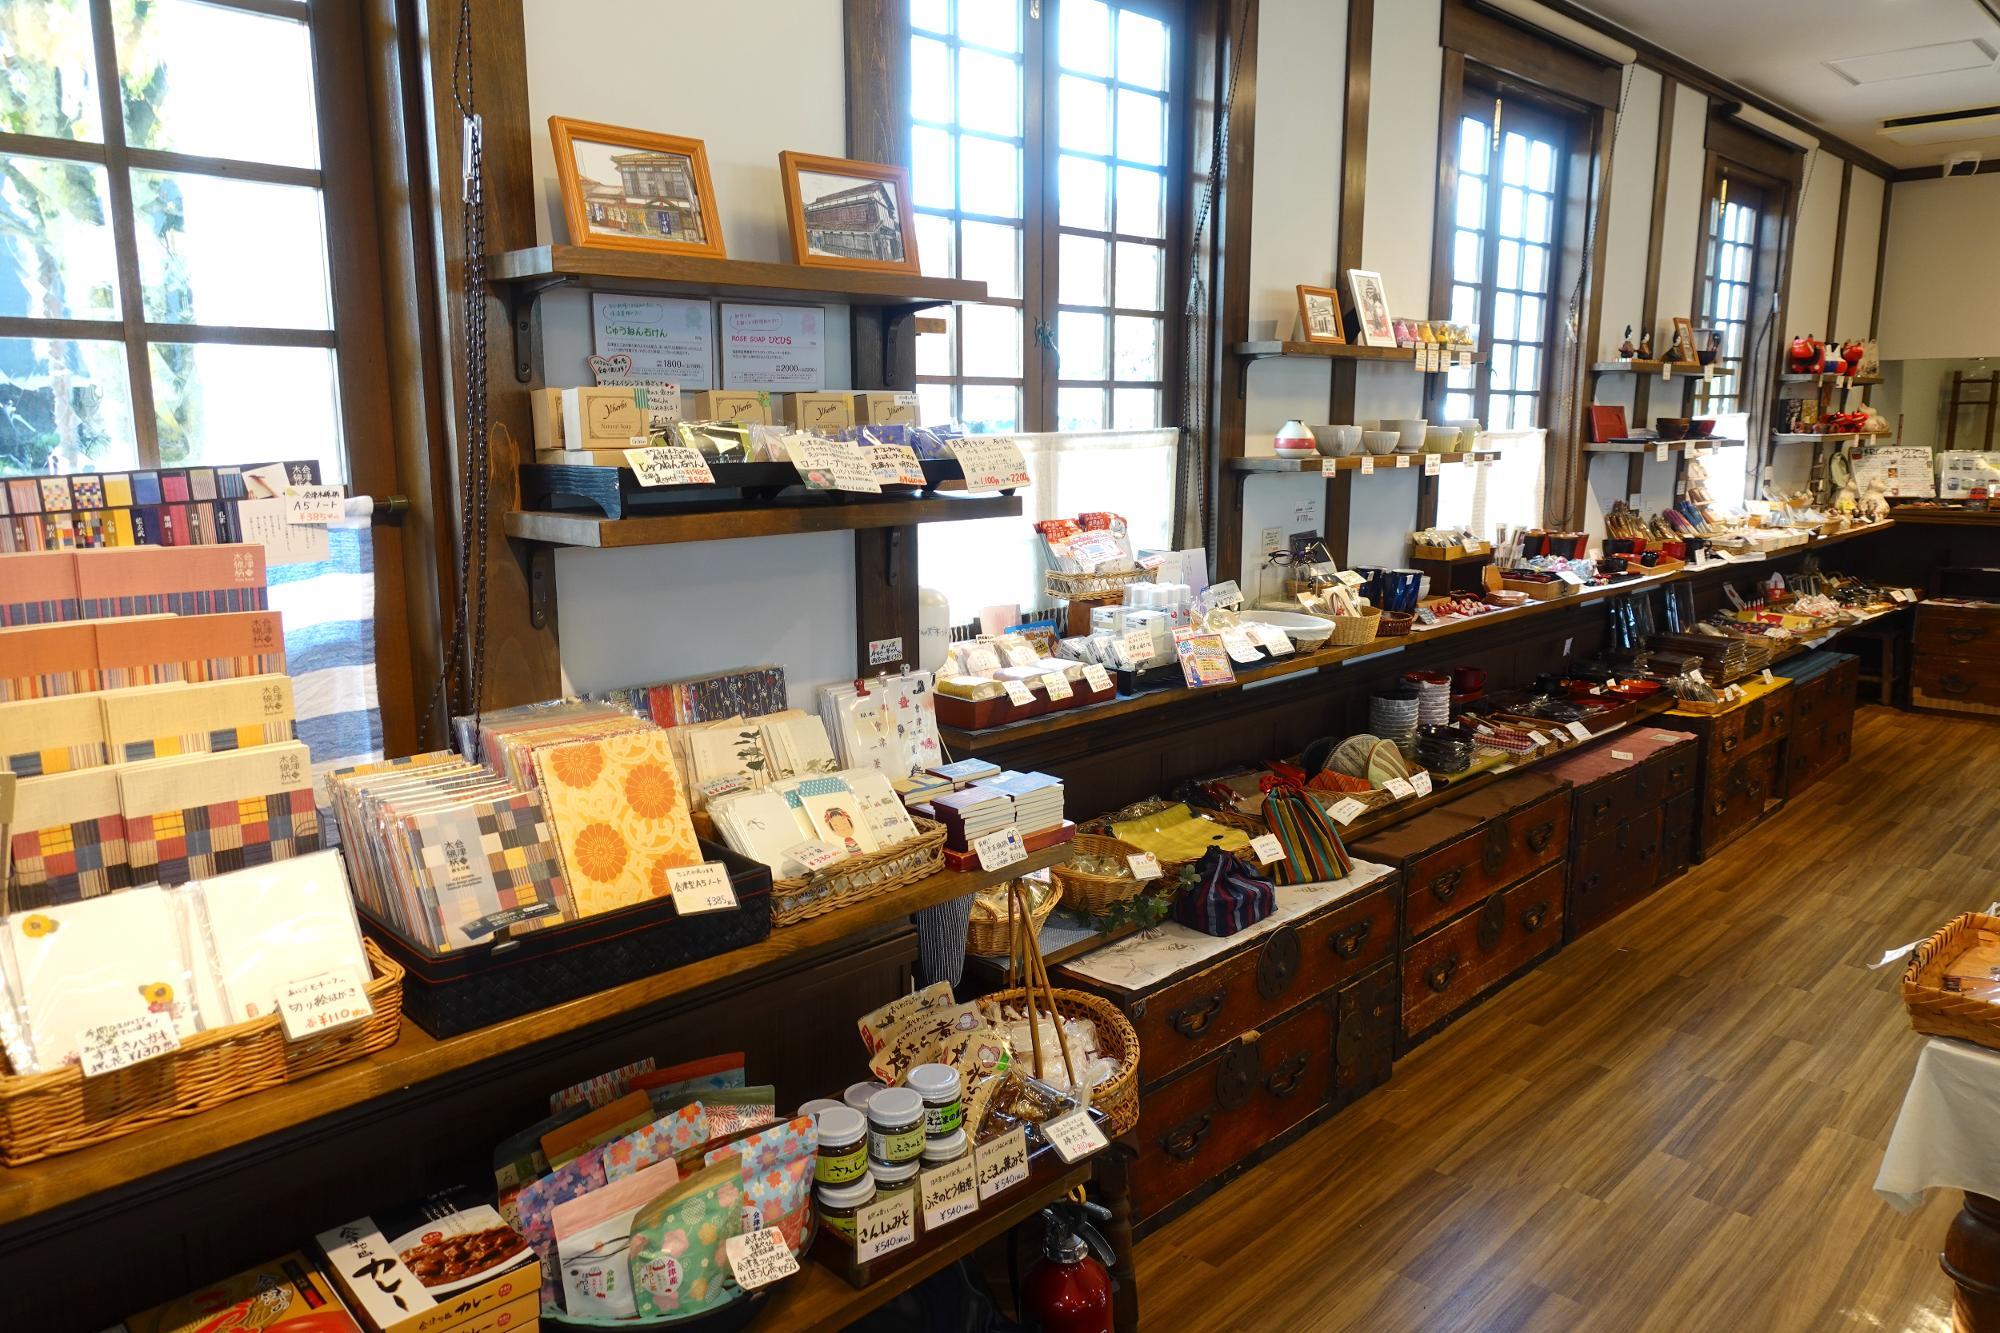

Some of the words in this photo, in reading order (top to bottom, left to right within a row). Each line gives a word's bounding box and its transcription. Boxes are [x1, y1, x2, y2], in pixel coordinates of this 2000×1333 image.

[605, 325, 668, 338] じゅうねん石けん
[287, 988, 358, 1013] 切り絵はがき
[886, 1018, 956, 1077] 棒たら煮
[924, 1176, 975, 1211] ふきのとう佃煮
[994, 1174, 1015, 1191] ¥540
[939, 1205, 962, 1221] ¥540
[858, 1208, 910, 1245] さんしょみそ
[874, 1235, 896, 1253] ¥540
[352, 1257, 410, 1313] カレー
[454, 1293, 495, 1316] カレー
